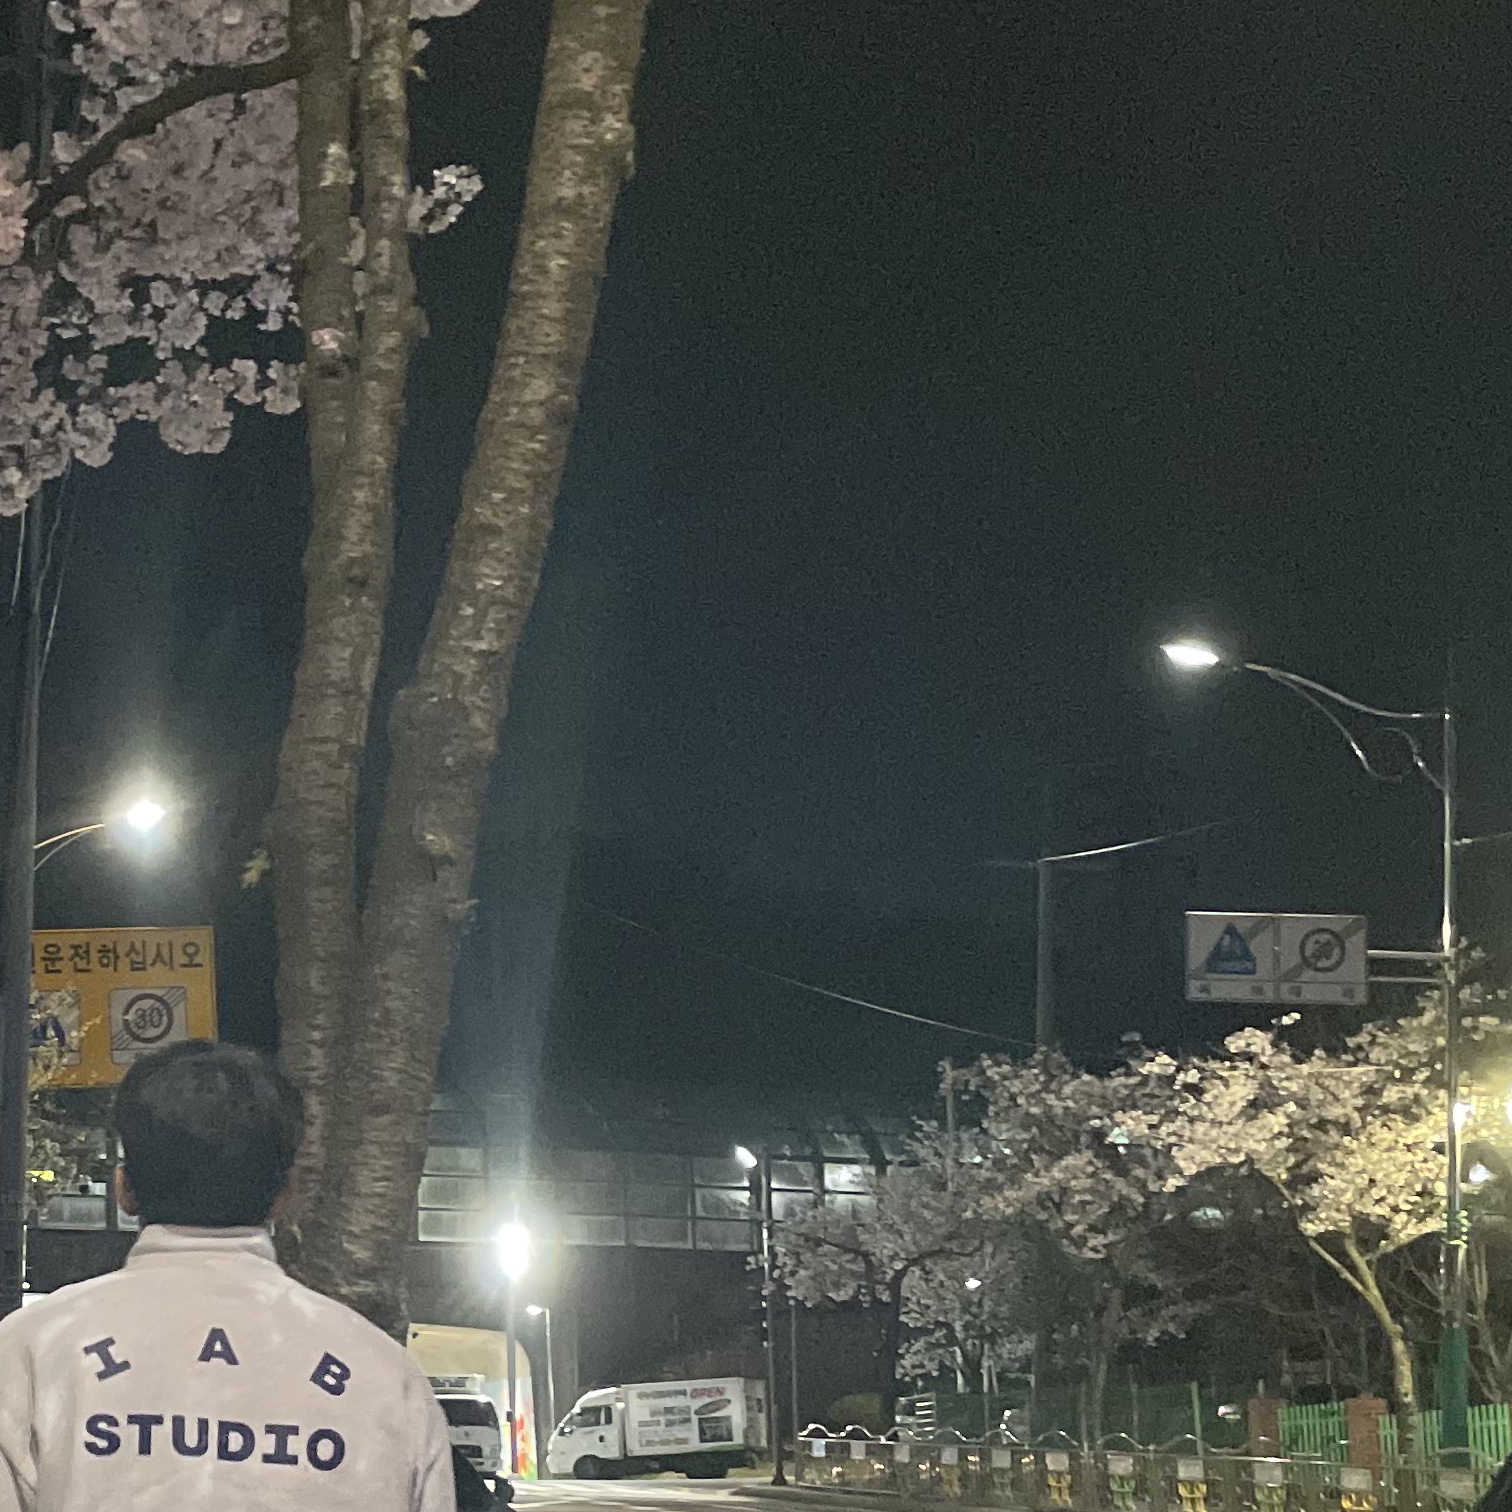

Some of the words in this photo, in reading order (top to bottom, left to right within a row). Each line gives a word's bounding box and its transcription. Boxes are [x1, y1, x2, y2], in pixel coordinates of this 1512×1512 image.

[32, 940, 204, 975] 운전하십시오
[135, 1007, 163, 1029] 30
[84, 1413, 346, 1472] STUDIO
